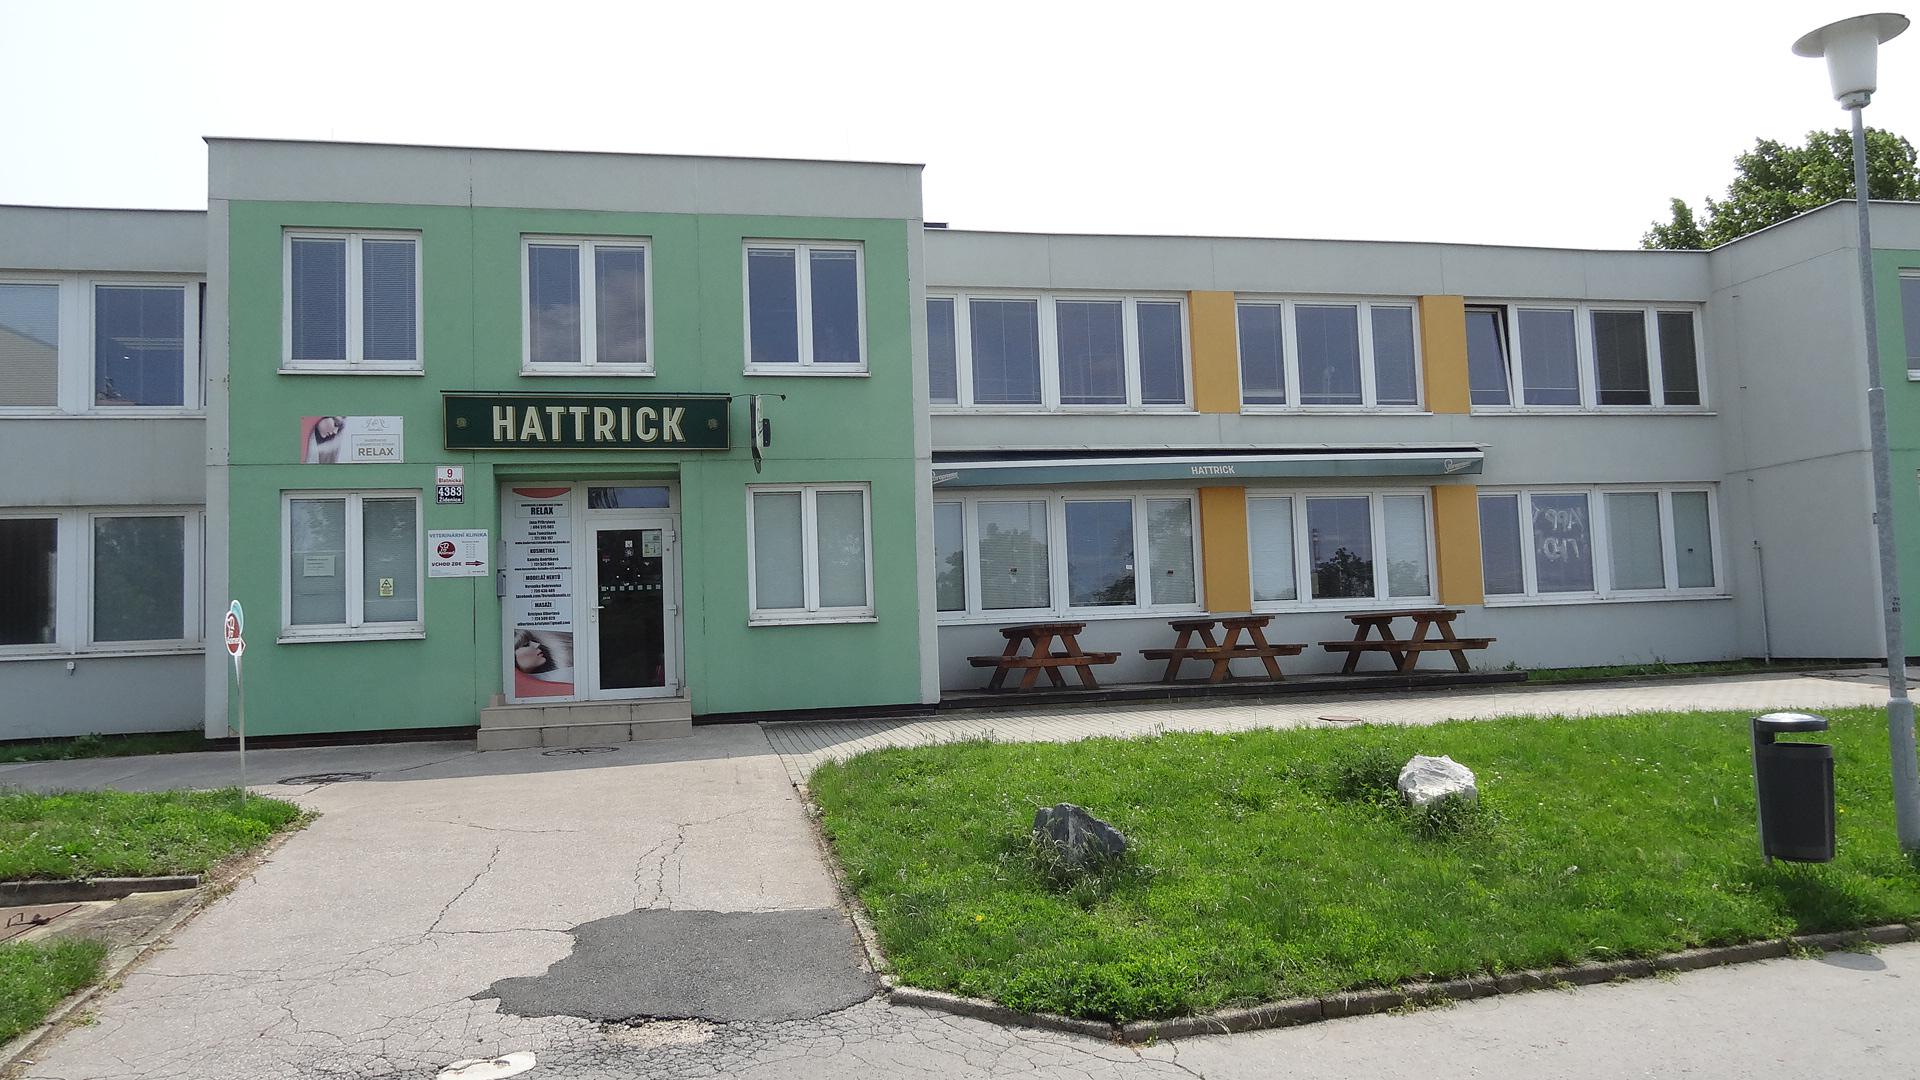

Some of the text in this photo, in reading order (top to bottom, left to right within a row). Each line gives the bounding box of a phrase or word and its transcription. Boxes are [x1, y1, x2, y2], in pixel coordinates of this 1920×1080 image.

[492, 405, 686, 443] HATTRICK
[358, 447, 394, 456] RELAX
[447, 468, 453, 478] 9
[1191, 465, 1235, 475] HATTRICK
[438, 486, 462, 497] 4383
[530, 507, 554, 515] RELAX
